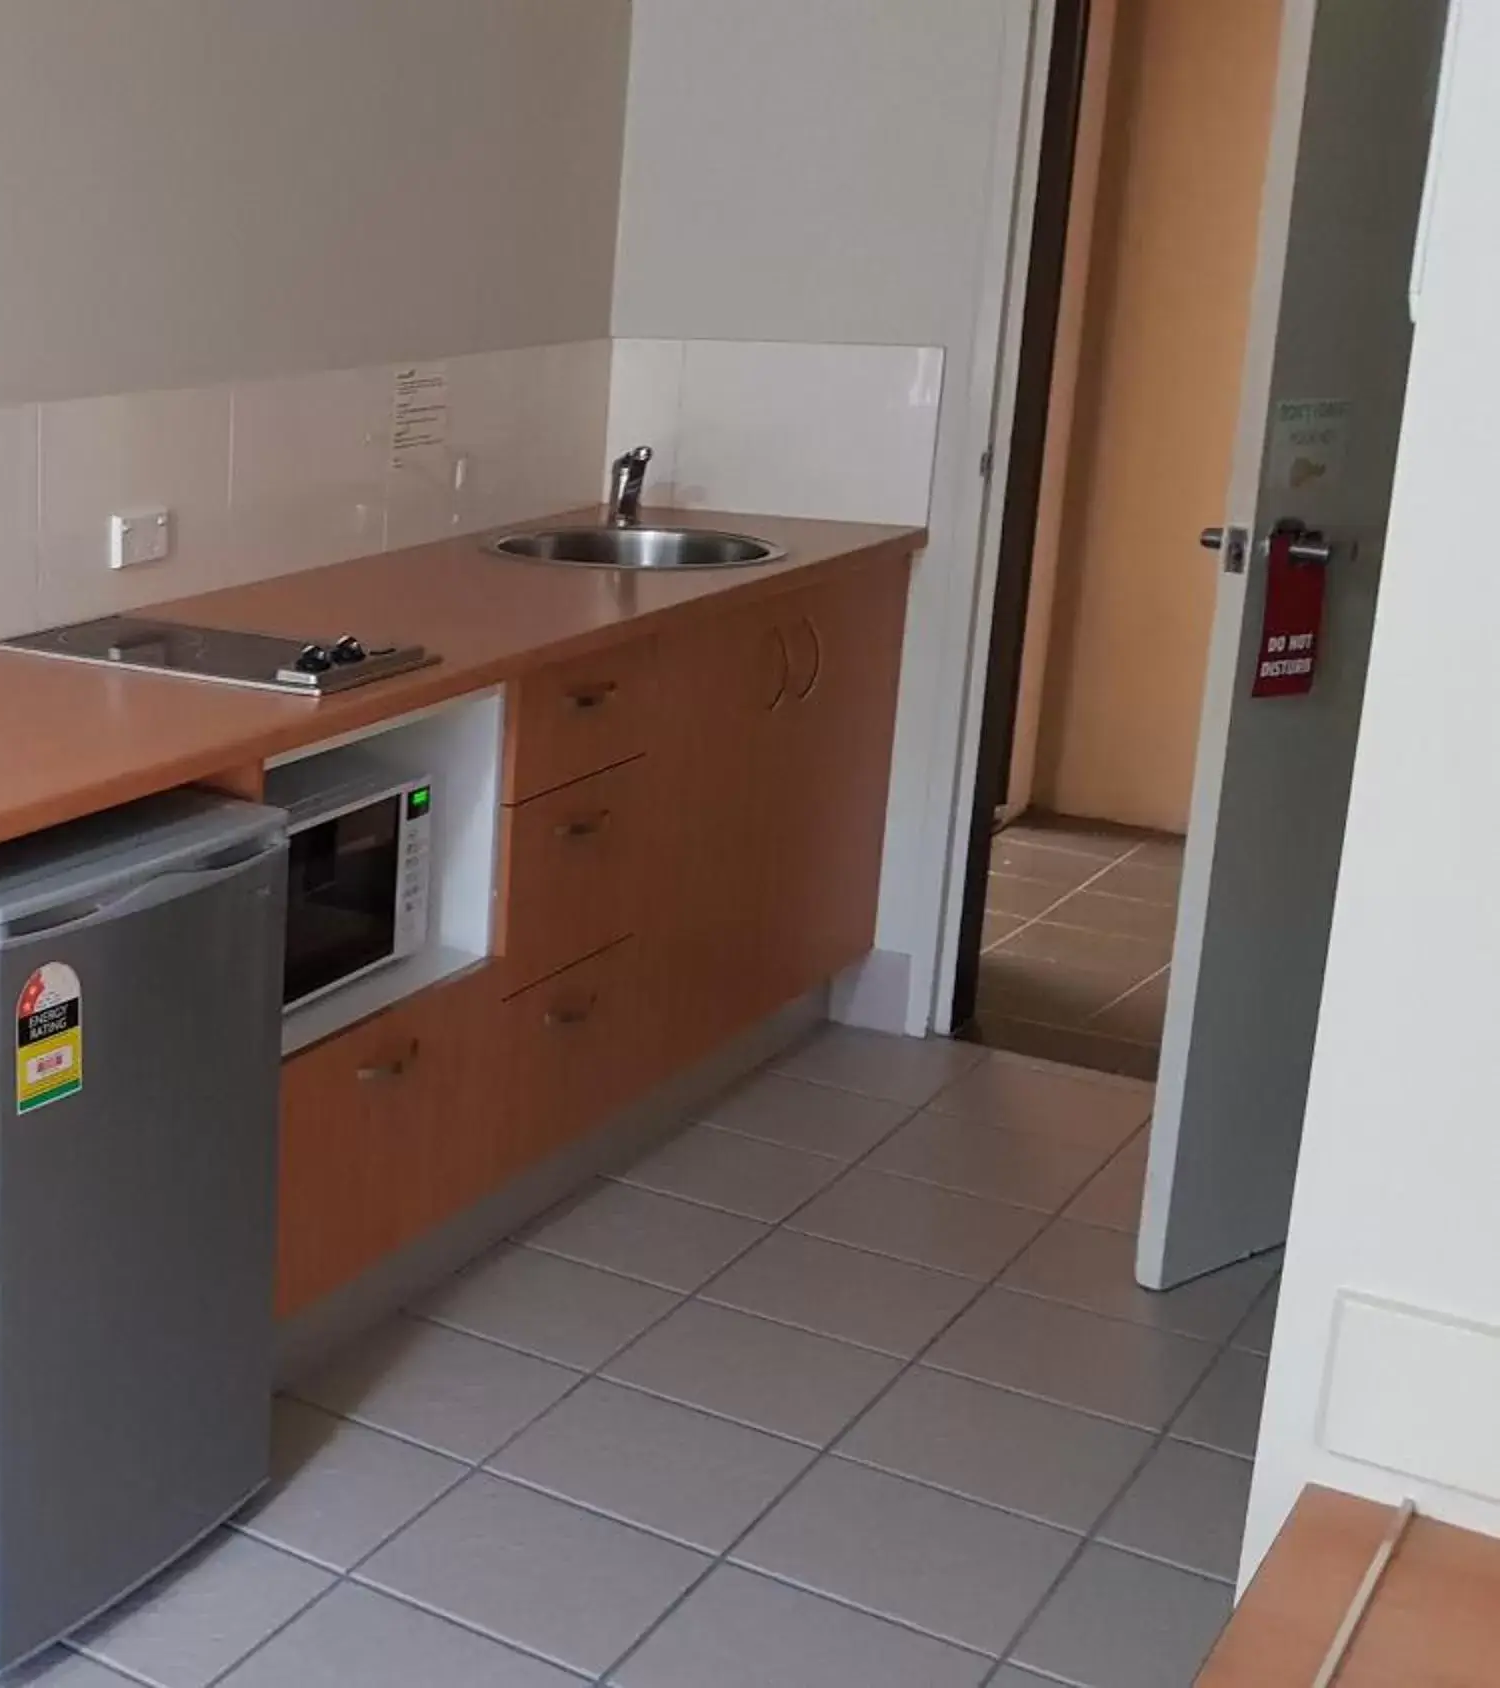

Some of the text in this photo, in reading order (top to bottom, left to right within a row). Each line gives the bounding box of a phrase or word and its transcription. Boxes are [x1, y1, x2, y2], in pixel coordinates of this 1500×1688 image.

[1268, 633, 1313, 653] DO NOT
[1260, 658, 1312, 677] DISTURB
[29, 1004, 68, 1029] ENERGY
[29, 1018, 67, 1040] RATING
